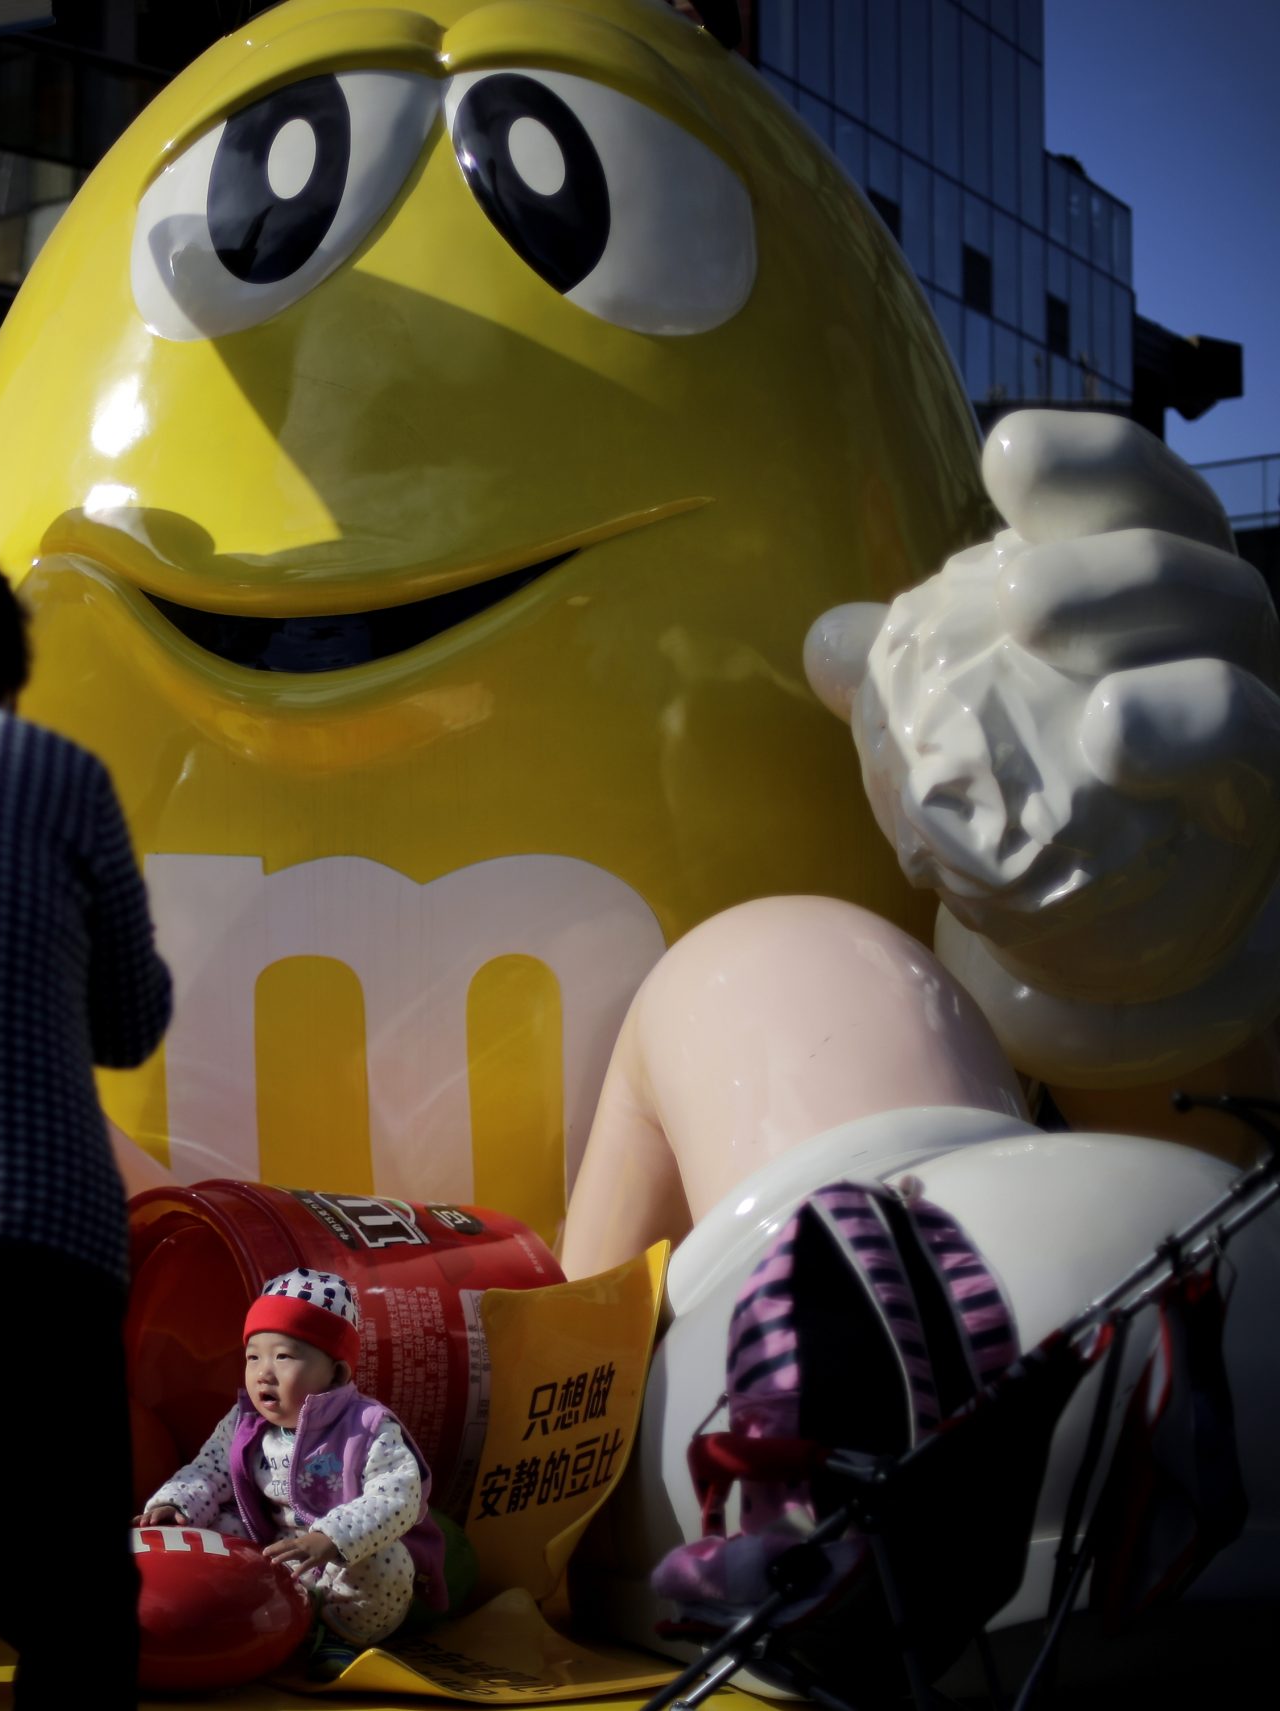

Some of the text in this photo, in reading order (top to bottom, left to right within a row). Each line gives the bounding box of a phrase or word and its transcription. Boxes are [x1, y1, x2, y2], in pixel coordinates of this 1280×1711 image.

[144, 853, 668, 1206] m
[522, 1361, 616, 1441] 只想做
[474, 1428, 624, 1520] 安静的豆比
